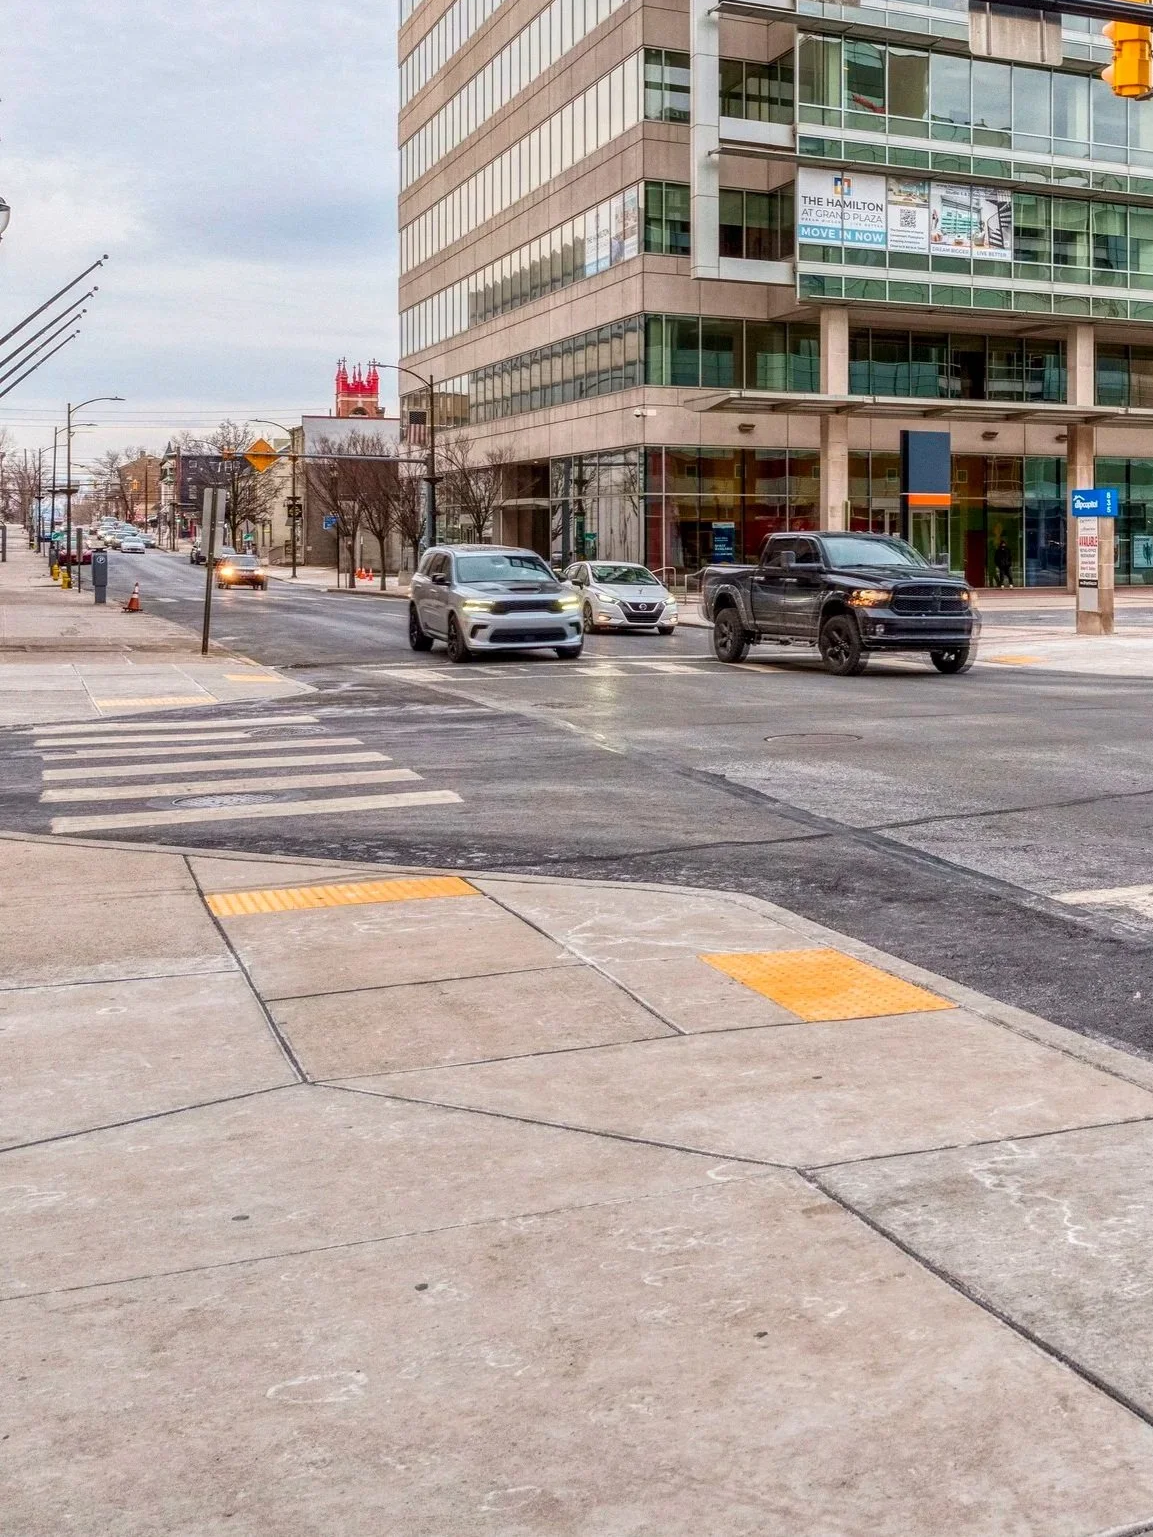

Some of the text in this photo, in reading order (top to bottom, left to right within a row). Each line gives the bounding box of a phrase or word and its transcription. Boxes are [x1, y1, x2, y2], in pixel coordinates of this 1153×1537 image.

[802, 196, 883, 212] THE HAMILTON
[802, 209, 813, 217] AT
[816, 210, 850, 220] GRAND
[853, 213, 882, 223] PLAZA
[802, 227, 836, 238] MOVE
[839, 230, 851, 240] IN
[856, 231, 884, 242] NOW
